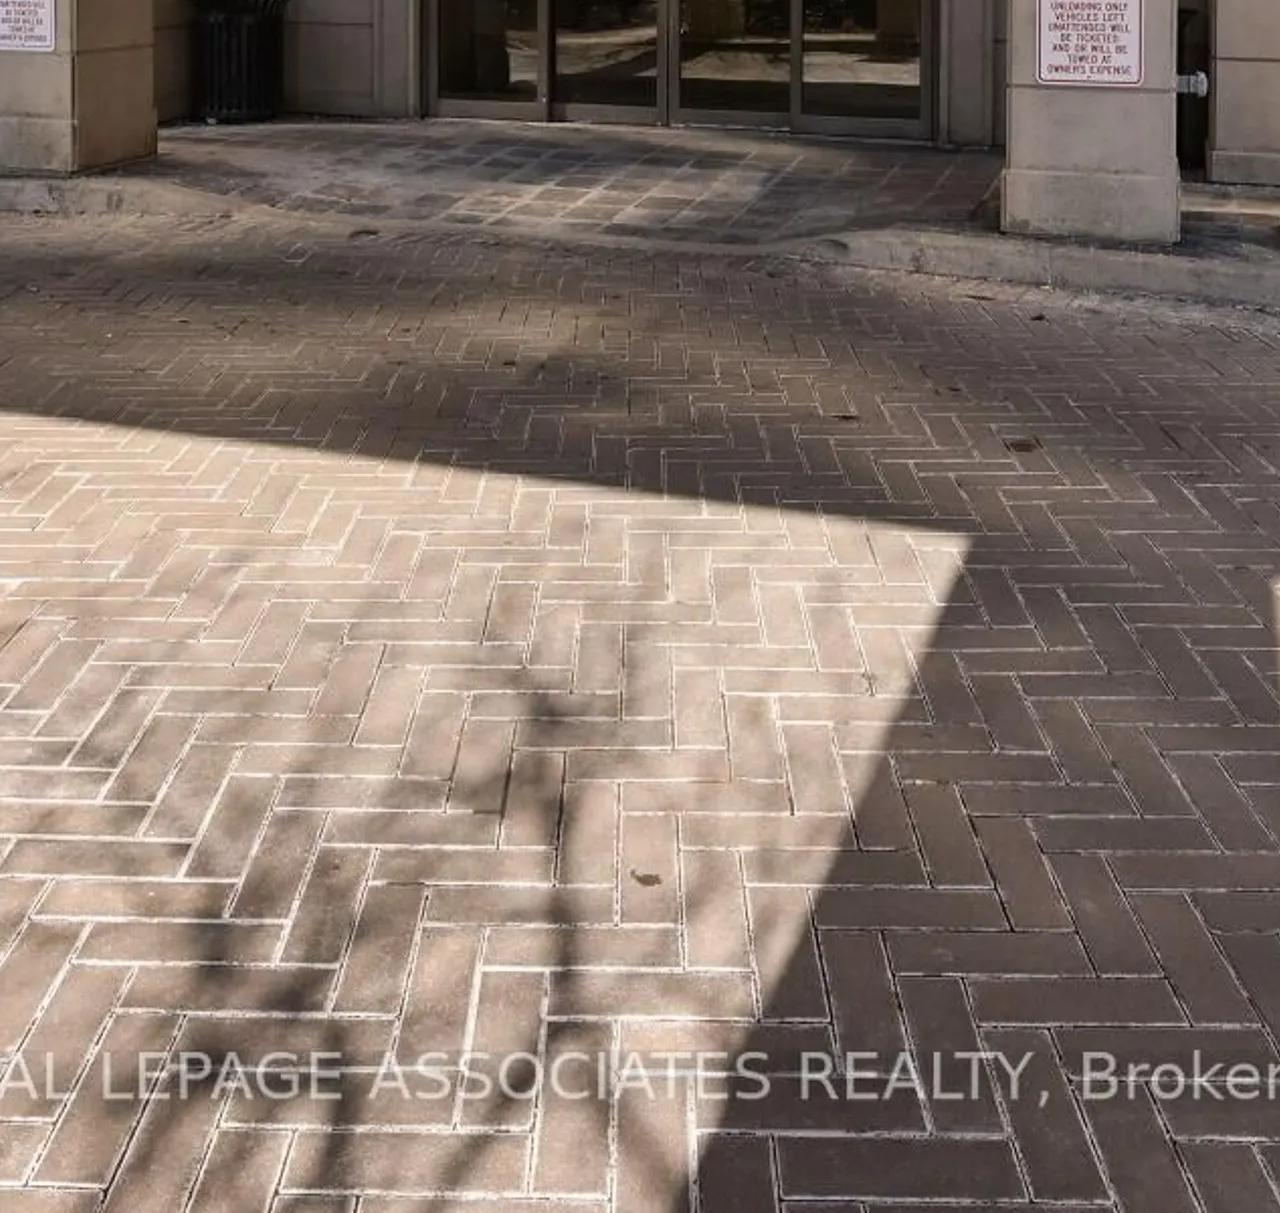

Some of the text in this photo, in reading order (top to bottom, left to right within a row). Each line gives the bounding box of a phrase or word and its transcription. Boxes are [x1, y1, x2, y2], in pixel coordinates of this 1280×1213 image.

[1050, 2, 1128, 12] UNLOADING ONLY
[1054, 12, 1125, 22] VEHICLES LEFT
[1048, 23, 1130, 34] UNATTENDED WILL
[1060, 33, 1119, 43] BE TICKETED
[1052, 43, 1128, 55] AND OR WILL BE
